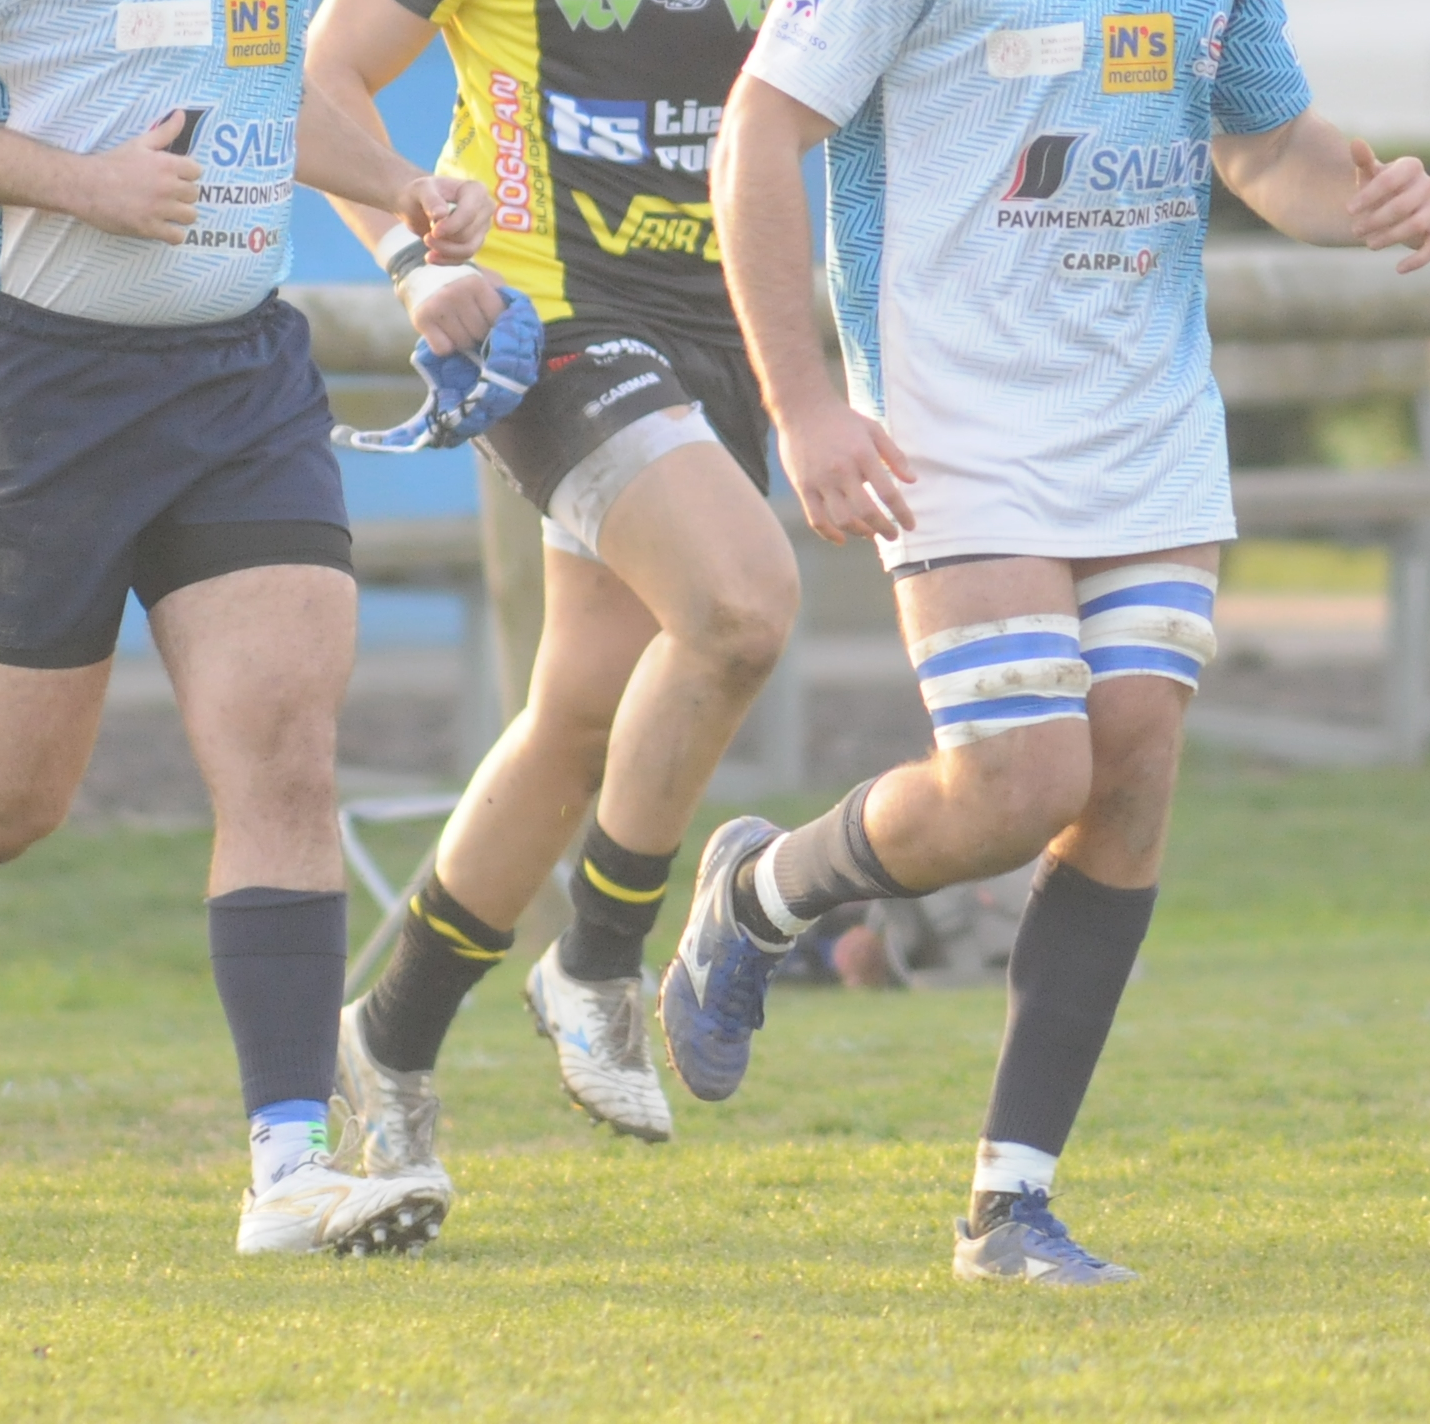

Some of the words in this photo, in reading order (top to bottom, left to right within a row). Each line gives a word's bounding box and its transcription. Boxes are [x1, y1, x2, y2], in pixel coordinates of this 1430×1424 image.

[230, 0, 280, 33] iN's
[232, 40, 281, 58] mercato
[1109, 26, 1167, 58] iN's
[1108, 67, 1168, 84] mercato
[998, 207, 1150, 229] PAVIMENTAZONI
[184, 226, 279, 254] ARPILOCK
[1062, 249, 1161, 277] CARPILOK
